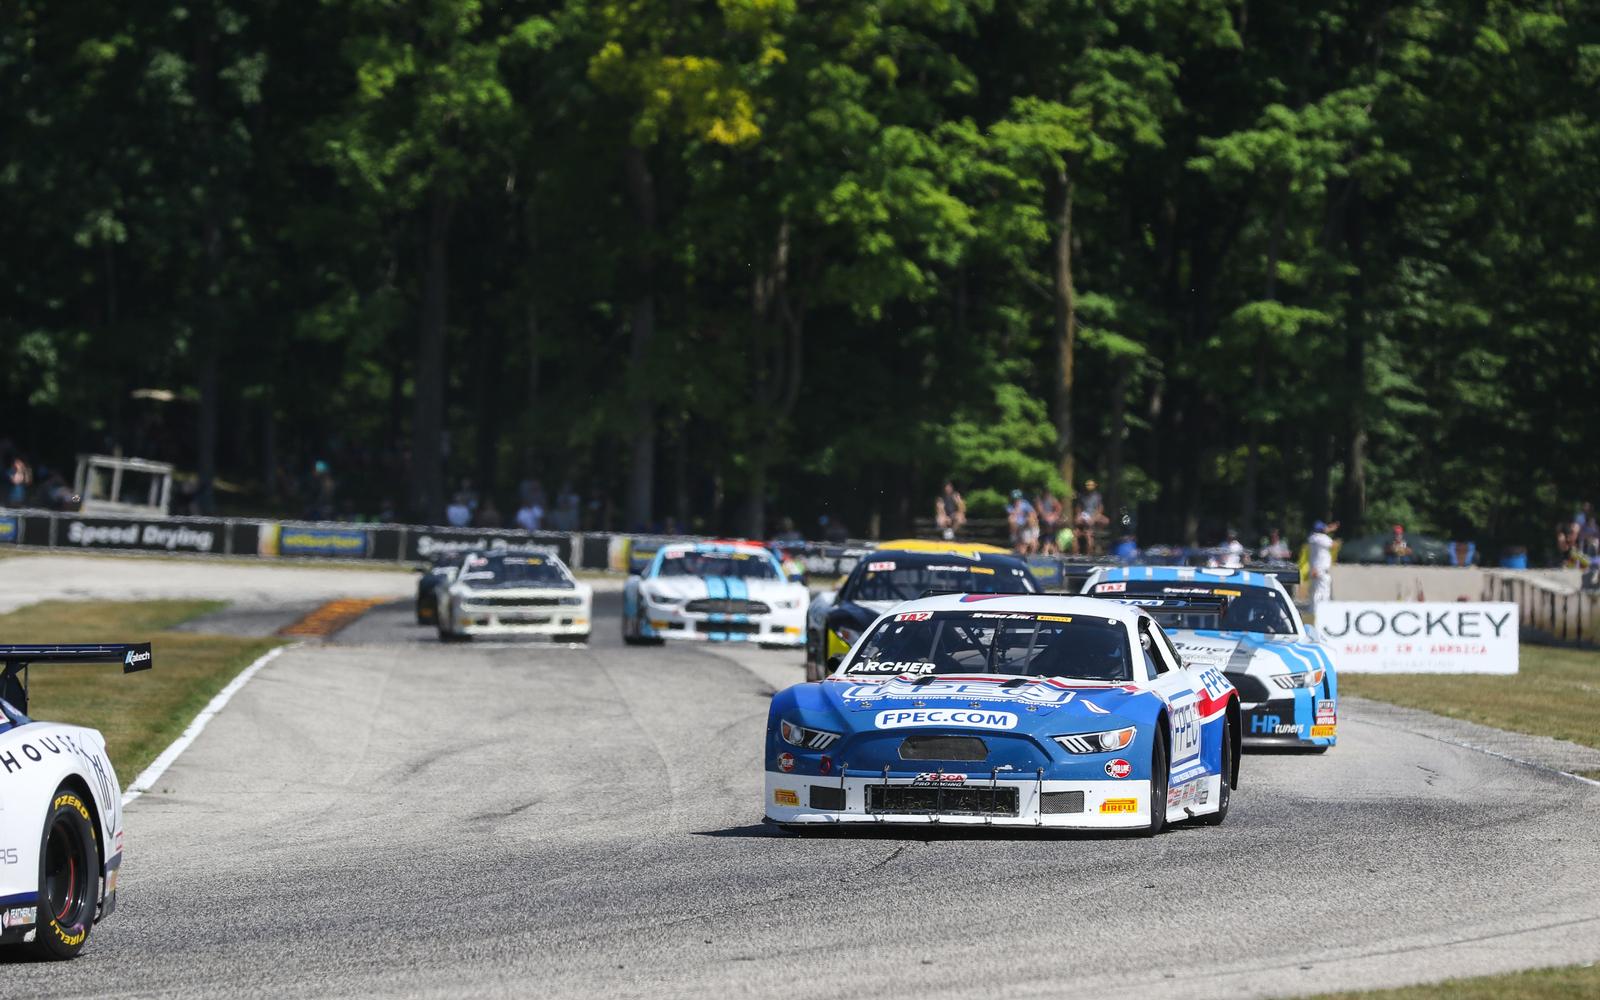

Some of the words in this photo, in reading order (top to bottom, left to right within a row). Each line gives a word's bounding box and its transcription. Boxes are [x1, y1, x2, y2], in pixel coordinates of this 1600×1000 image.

[69, 521, 139, 546] Speed
[142, 526, 214, 551] Drying
[900, 613, 929, 622] TA2
[1323, 611, 1511, 638] JOCKEY
[125, 650, 150, 665] Katech
[847, 661, 936, 677] ARCHER
[882, 711, 1009, 727] FPEC.COM
[1251, 714, 1281, 734] HP
[1275, 723, 1304, 735] tuners
[929, 773, 964, 781] SCCA
[1101, 800, 1136, 813] PIRELLI
[49, 919, 86, 946] PIRELLI
